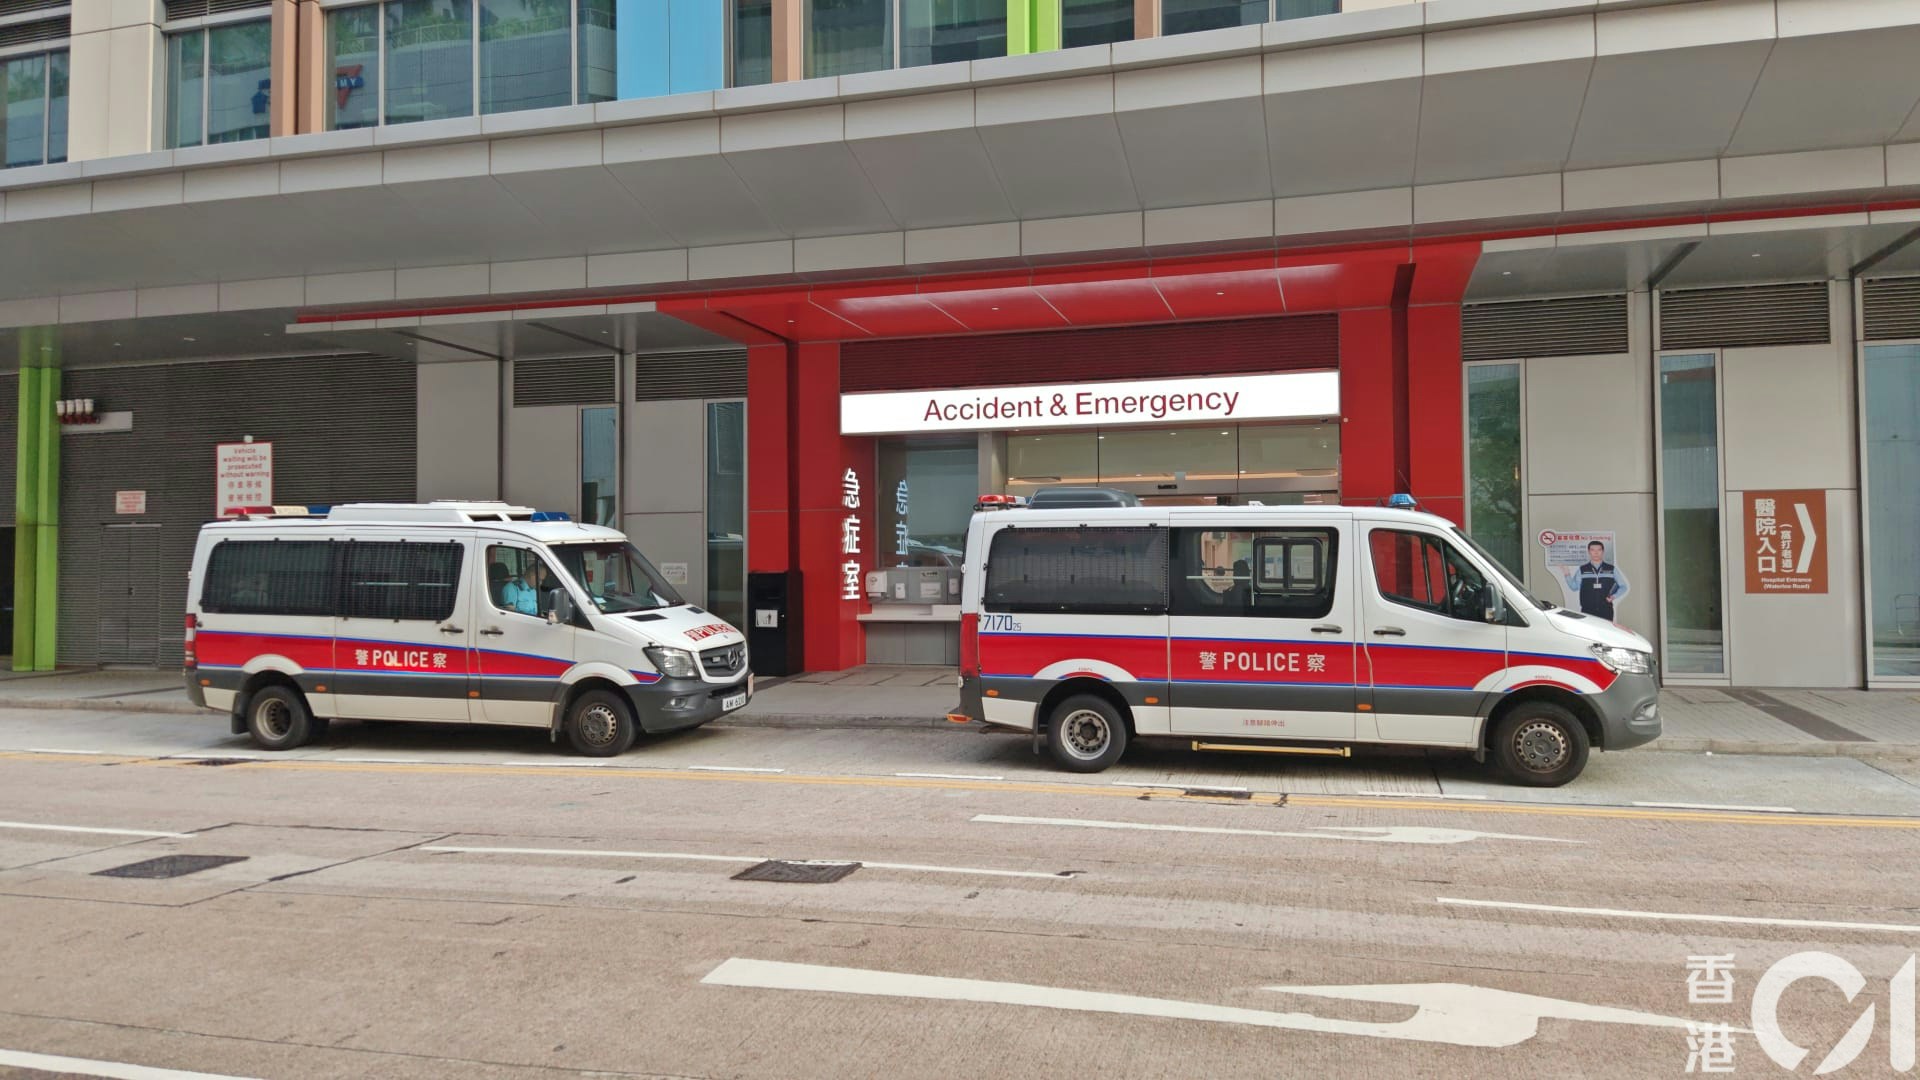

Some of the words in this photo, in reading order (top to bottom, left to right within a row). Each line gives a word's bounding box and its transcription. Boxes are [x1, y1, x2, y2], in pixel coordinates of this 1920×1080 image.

[924, 396, 1043, 421] Accident
[1050, 393, 1068, 416] &
[1076, 391, 1239, 418] Emergency
[842, 467, 860, 600] 急症室
[1755, 498, 1777, 573] 醫院入口
[983, 615, 1012, 631] 7170
[355, 649, 368, 666] 警
[372, 649, 429, 668] POLICE
[433, 652, 447, 668] 察
[1199, 651, 1217, 670] 警
[1223, 651, 1300, 672] POLICE
[1307, 653, 1326, 672] 察
